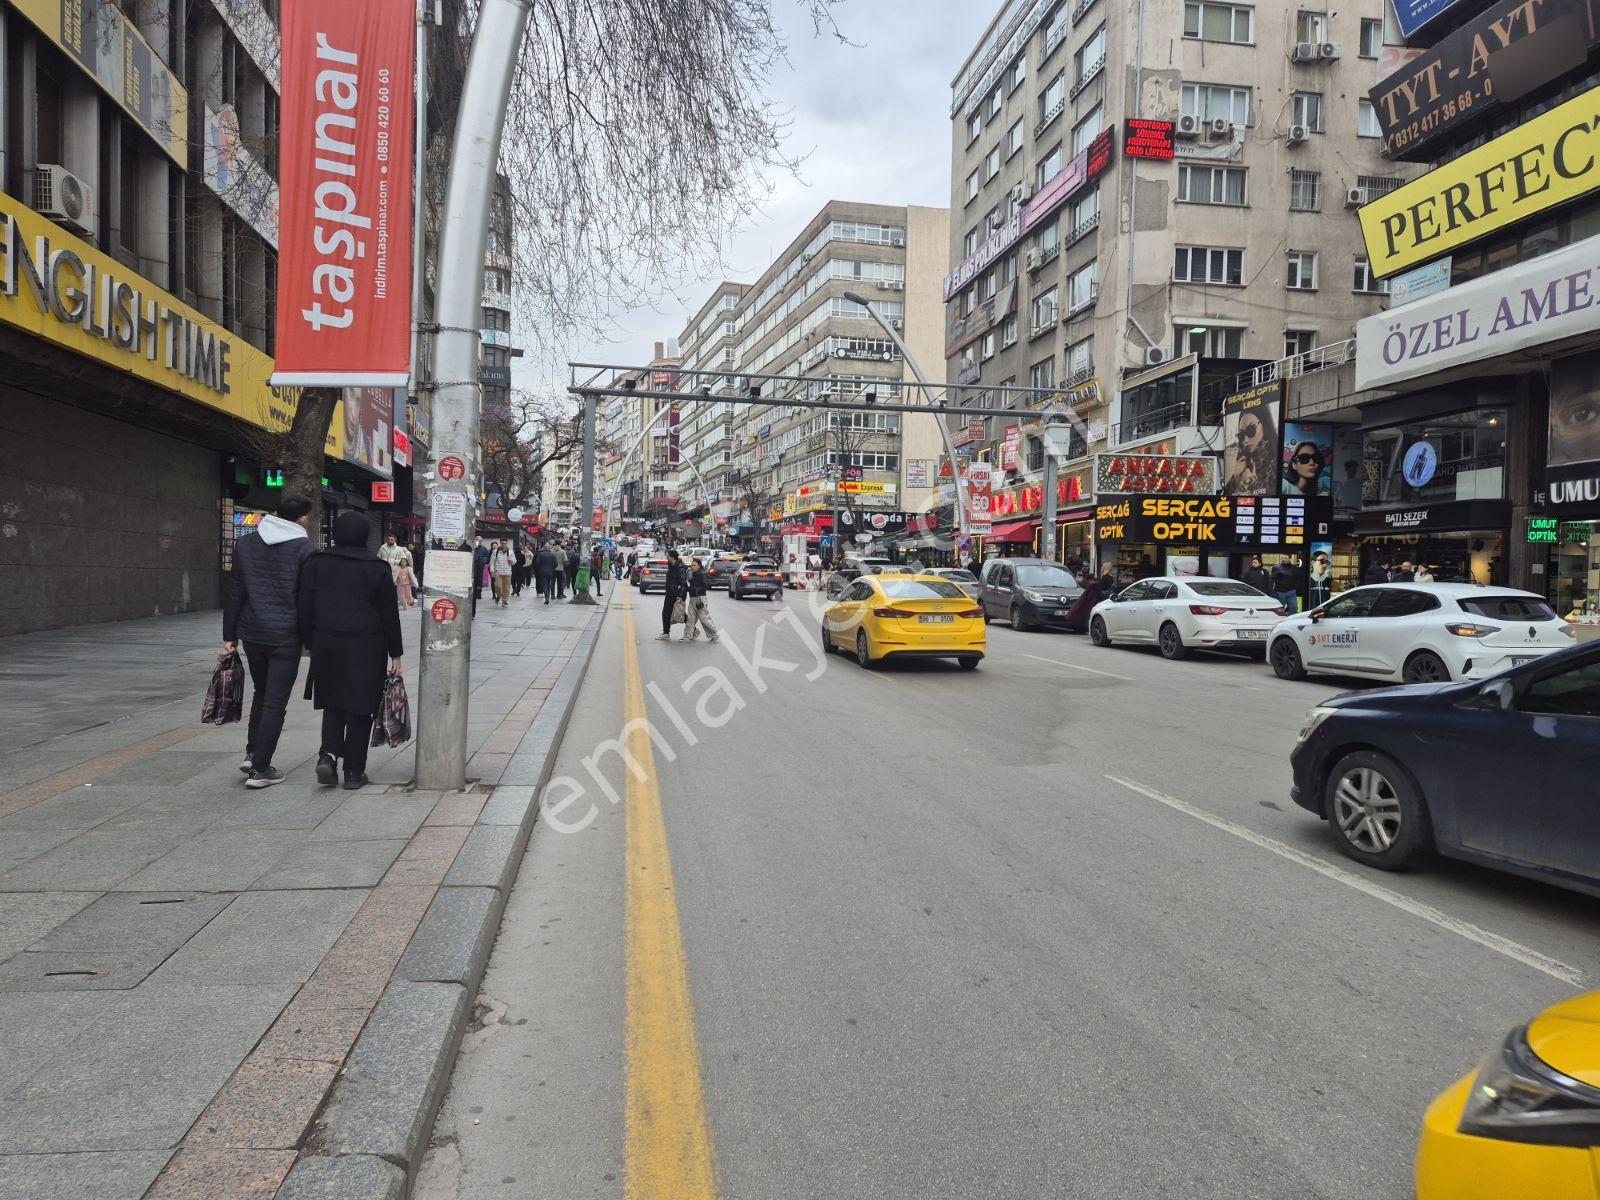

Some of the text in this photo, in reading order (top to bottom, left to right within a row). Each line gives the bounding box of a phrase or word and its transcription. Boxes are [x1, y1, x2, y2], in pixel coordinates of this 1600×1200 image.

[1381, 59, 1441, 127] TYT
[1395, 122, 1420, 148] 0312
[1421, 109, 1439, 132] 417
[1442, 101, 1456, 120] 36
[1458, 90, 1473, 111] 68
[302, 32, 371, 331] taşpınar
[374, 69, 389, 299] indirim.taspinar.com 0850 420 60 60
[1383, 264, 1600, 366] ÖZEL AME
[161, 306, 231, 394] TIME
[1107, 457, 1205, 476] ANKARA
[860, 484, 883, 492] Express
[1120, 476, 1194, 491] ASPAVA
[1097, 501, 1130, 521] SERÇAĞ
[1142, 497, 1231, 522] SERÇAĞ
[1403, 511, 1428, 522] SEZER
[1100, 522, 1124, 539] OPTİK
[1153, 519, 1216, 541] OPTİK
[1531, 519, 1557, 529] UMUT
[1529, 530, 1557, 541] OPTİK
